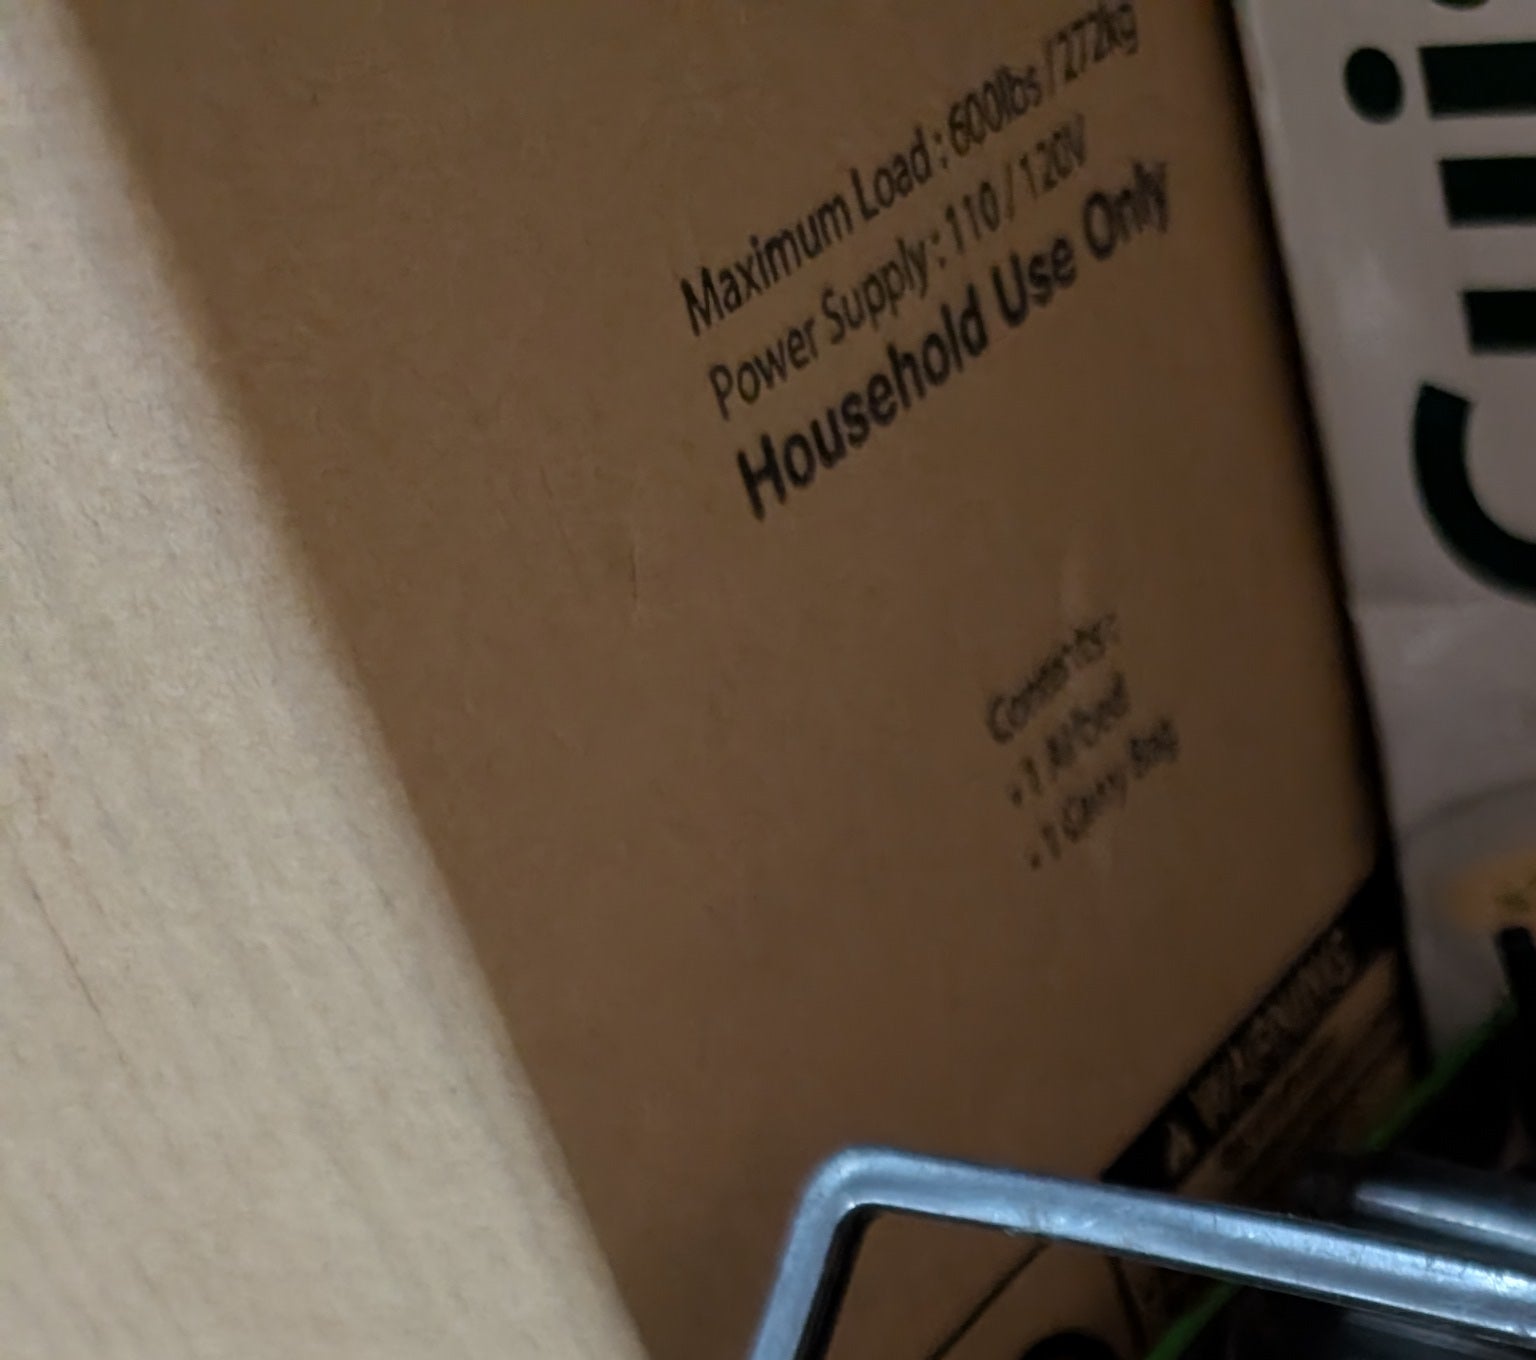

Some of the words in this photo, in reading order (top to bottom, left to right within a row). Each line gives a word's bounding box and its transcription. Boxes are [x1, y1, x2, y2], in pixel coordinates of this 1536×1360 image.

[680, 193, 855, 338] Maximum
[708, 316, 819, 422] Power
[737, 281, 989, 522] Household
[990, 236, 1077, 329] Use
[1081, 158, 1169, 262] Only
